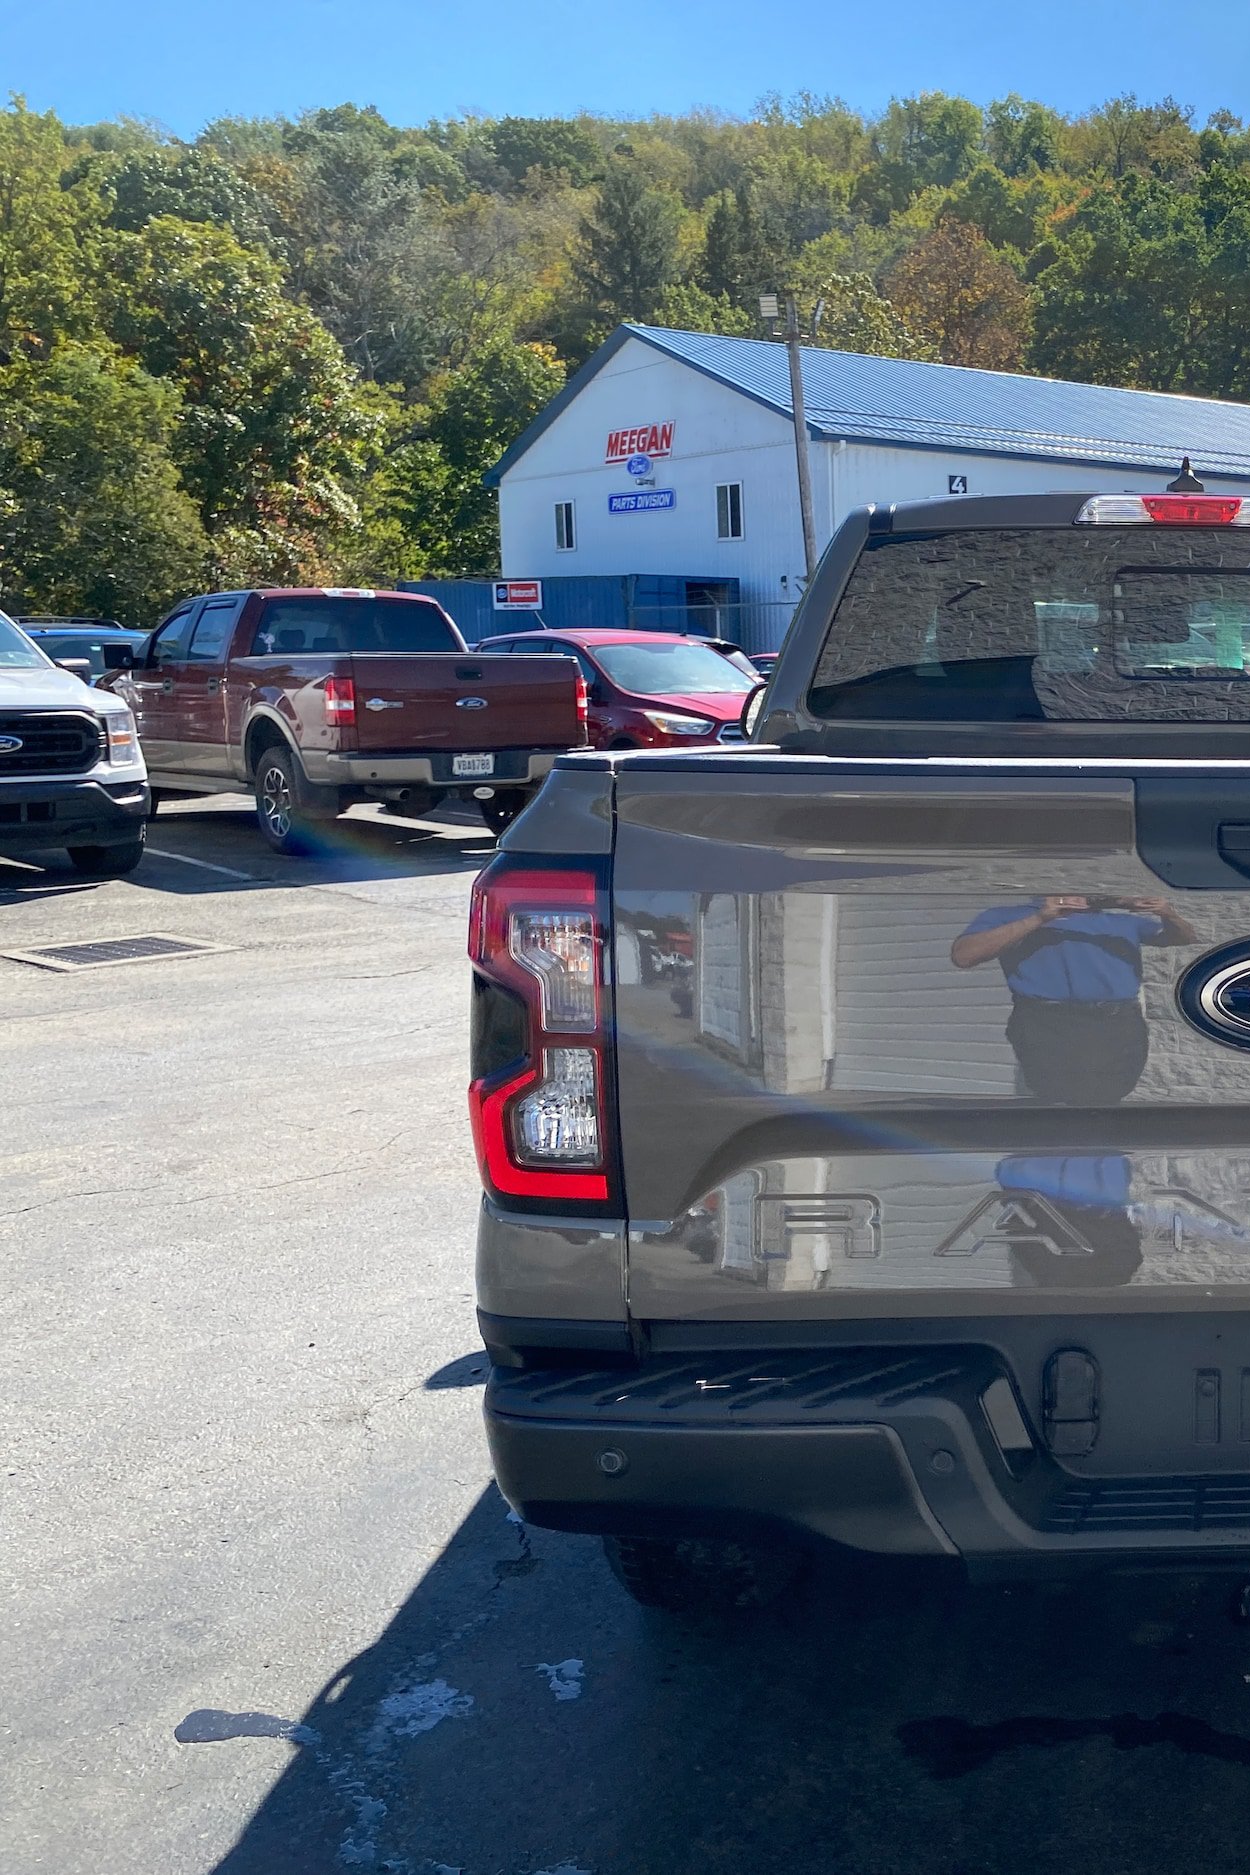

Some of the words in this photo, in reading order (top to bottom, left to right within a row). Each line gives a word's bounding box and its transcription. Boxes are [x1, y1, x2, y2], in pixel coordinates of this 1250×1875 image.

[606, 423, 673, 457] MEEGAN
[951, 476, 965, 494] 4
[611, 497, 636, 511] PARTS
[636, 493, 671, 509] DIVISION
